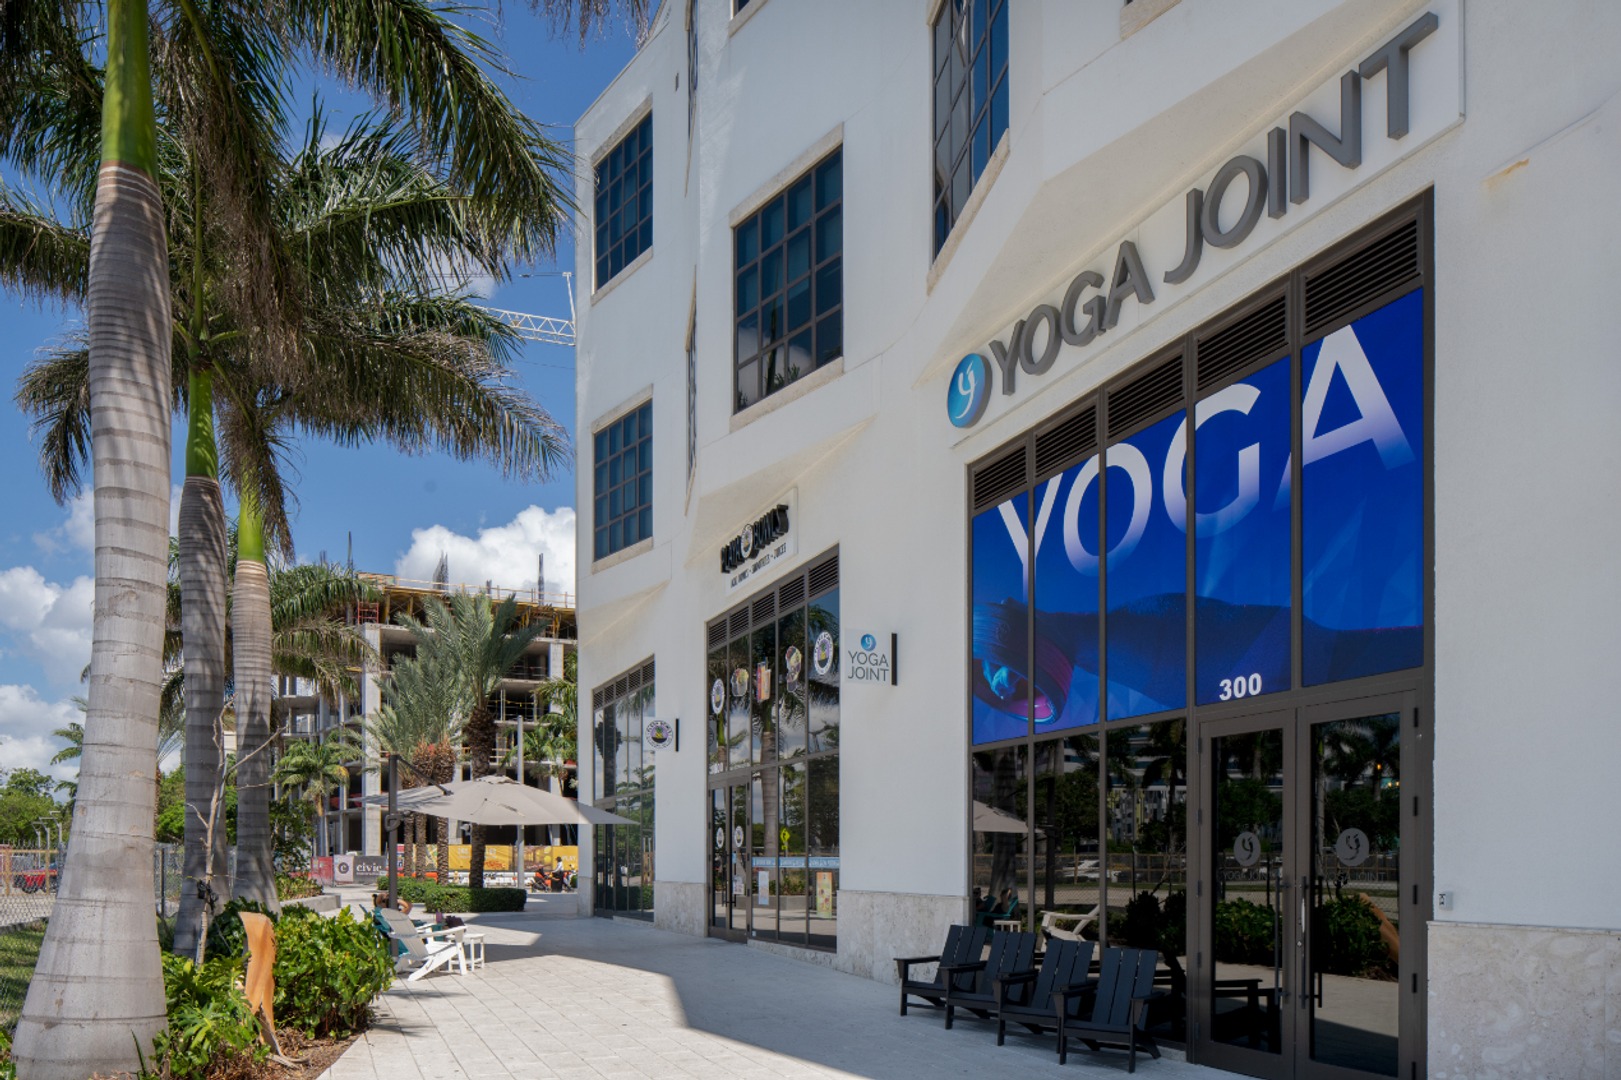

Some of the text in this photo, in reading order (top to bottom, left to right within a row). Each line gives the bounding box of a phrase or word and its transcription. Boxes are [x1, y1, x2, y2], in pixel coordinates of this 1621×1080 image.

[989, 11, 1438, 395] YOGA JOINT
[997, 324, 1416, 600] YOGA
[848, 650, 889, 667] YOGA
[848, 666, 889, 681] JOINT
[1219, 673, 1262, 701] 300
[356, 862, 382, 872] civic
